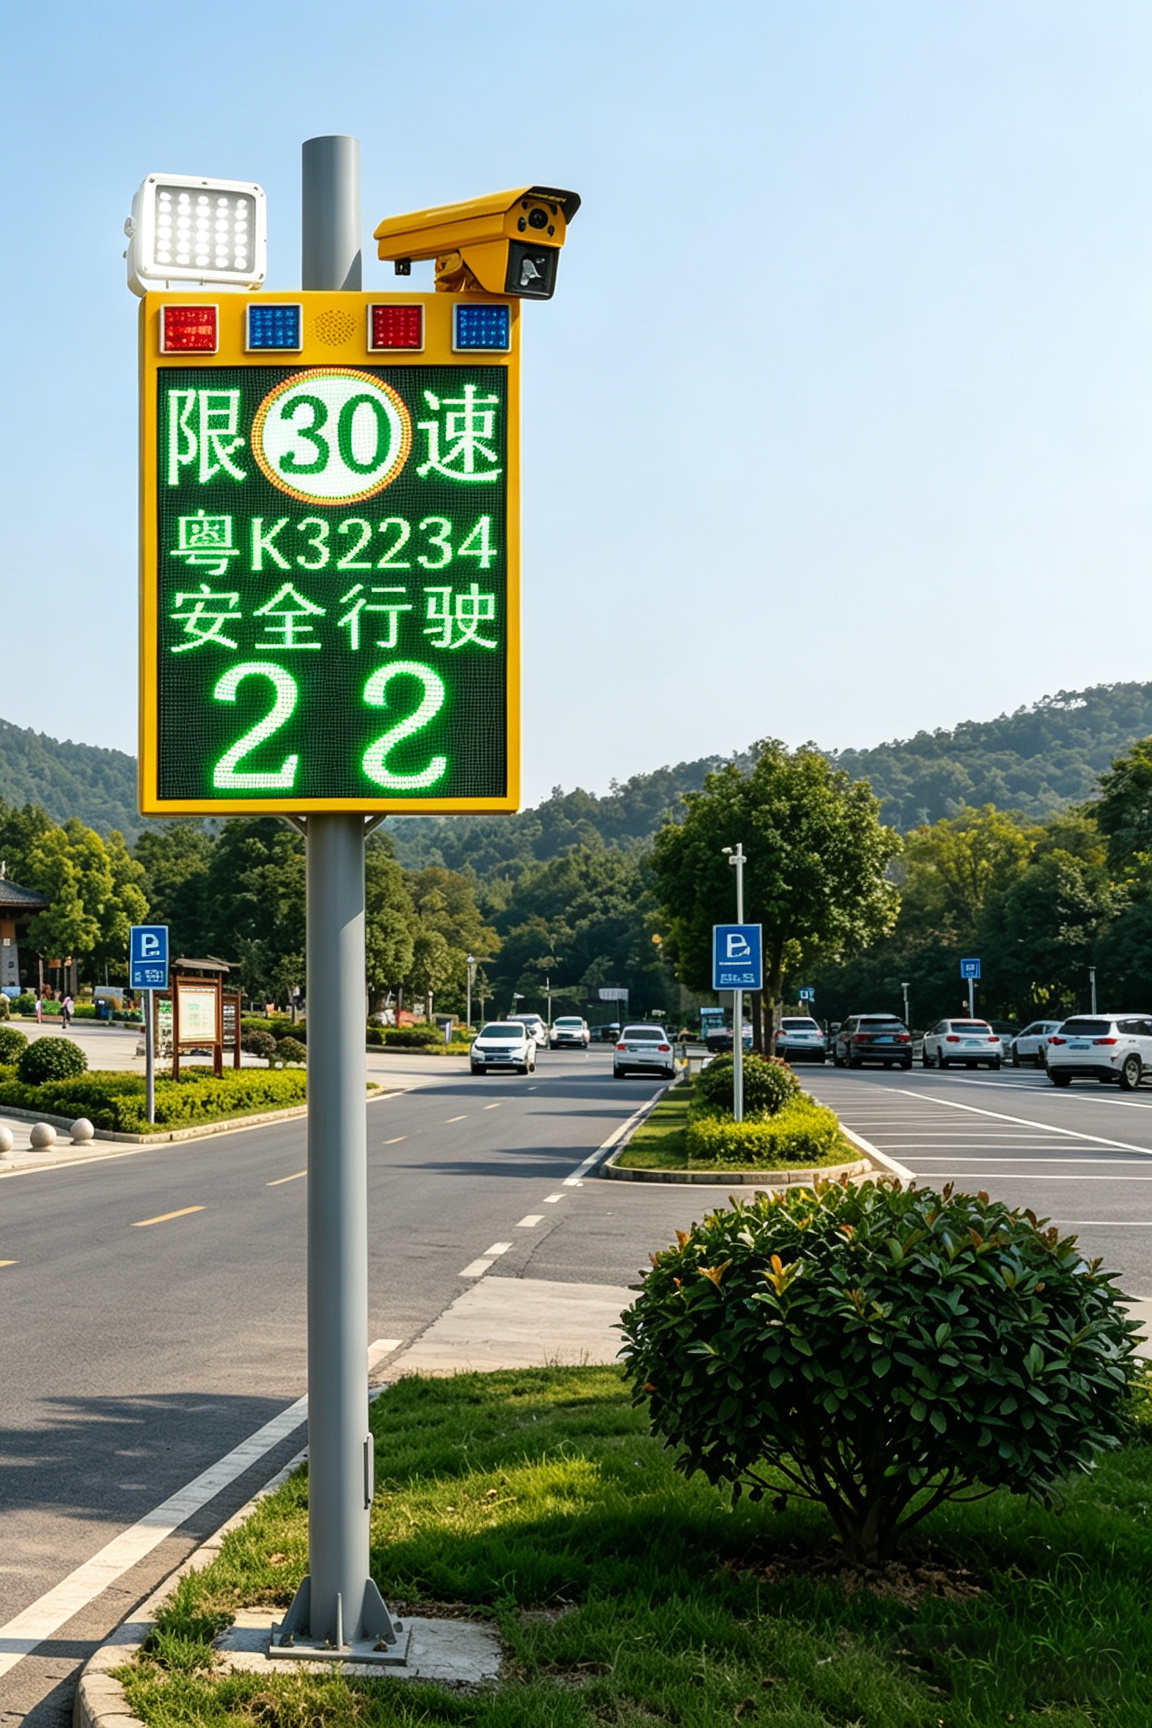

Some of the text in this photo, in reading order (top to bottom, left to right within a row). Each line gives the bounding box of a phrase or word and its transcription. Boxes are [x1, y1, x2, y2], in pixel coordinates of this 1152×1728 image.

[168, 384, 503, 486] 限 30 速
[170, 509, 498, 576] 粤K32234
[170, 582, 498, 653] 安全行驶
